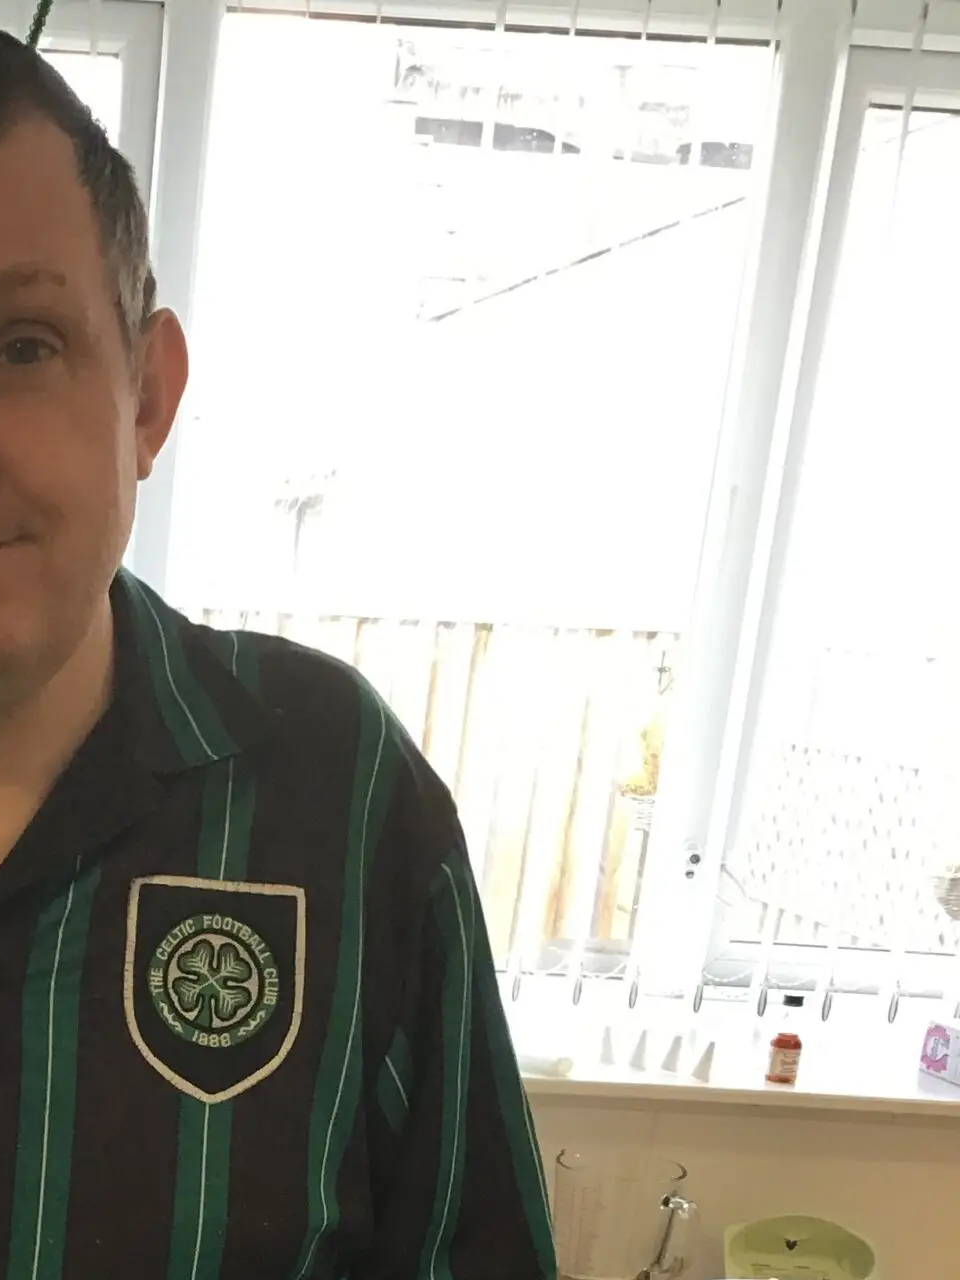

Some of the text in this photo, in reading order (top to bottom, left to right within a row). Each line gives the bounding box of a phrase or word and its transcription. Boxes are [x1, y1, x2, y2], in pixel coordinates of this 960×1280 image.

[150, 914, 279, 1005] THE CELTIC FOOTBALL CLUB
[192, 1031, 231, 1047] 1888
